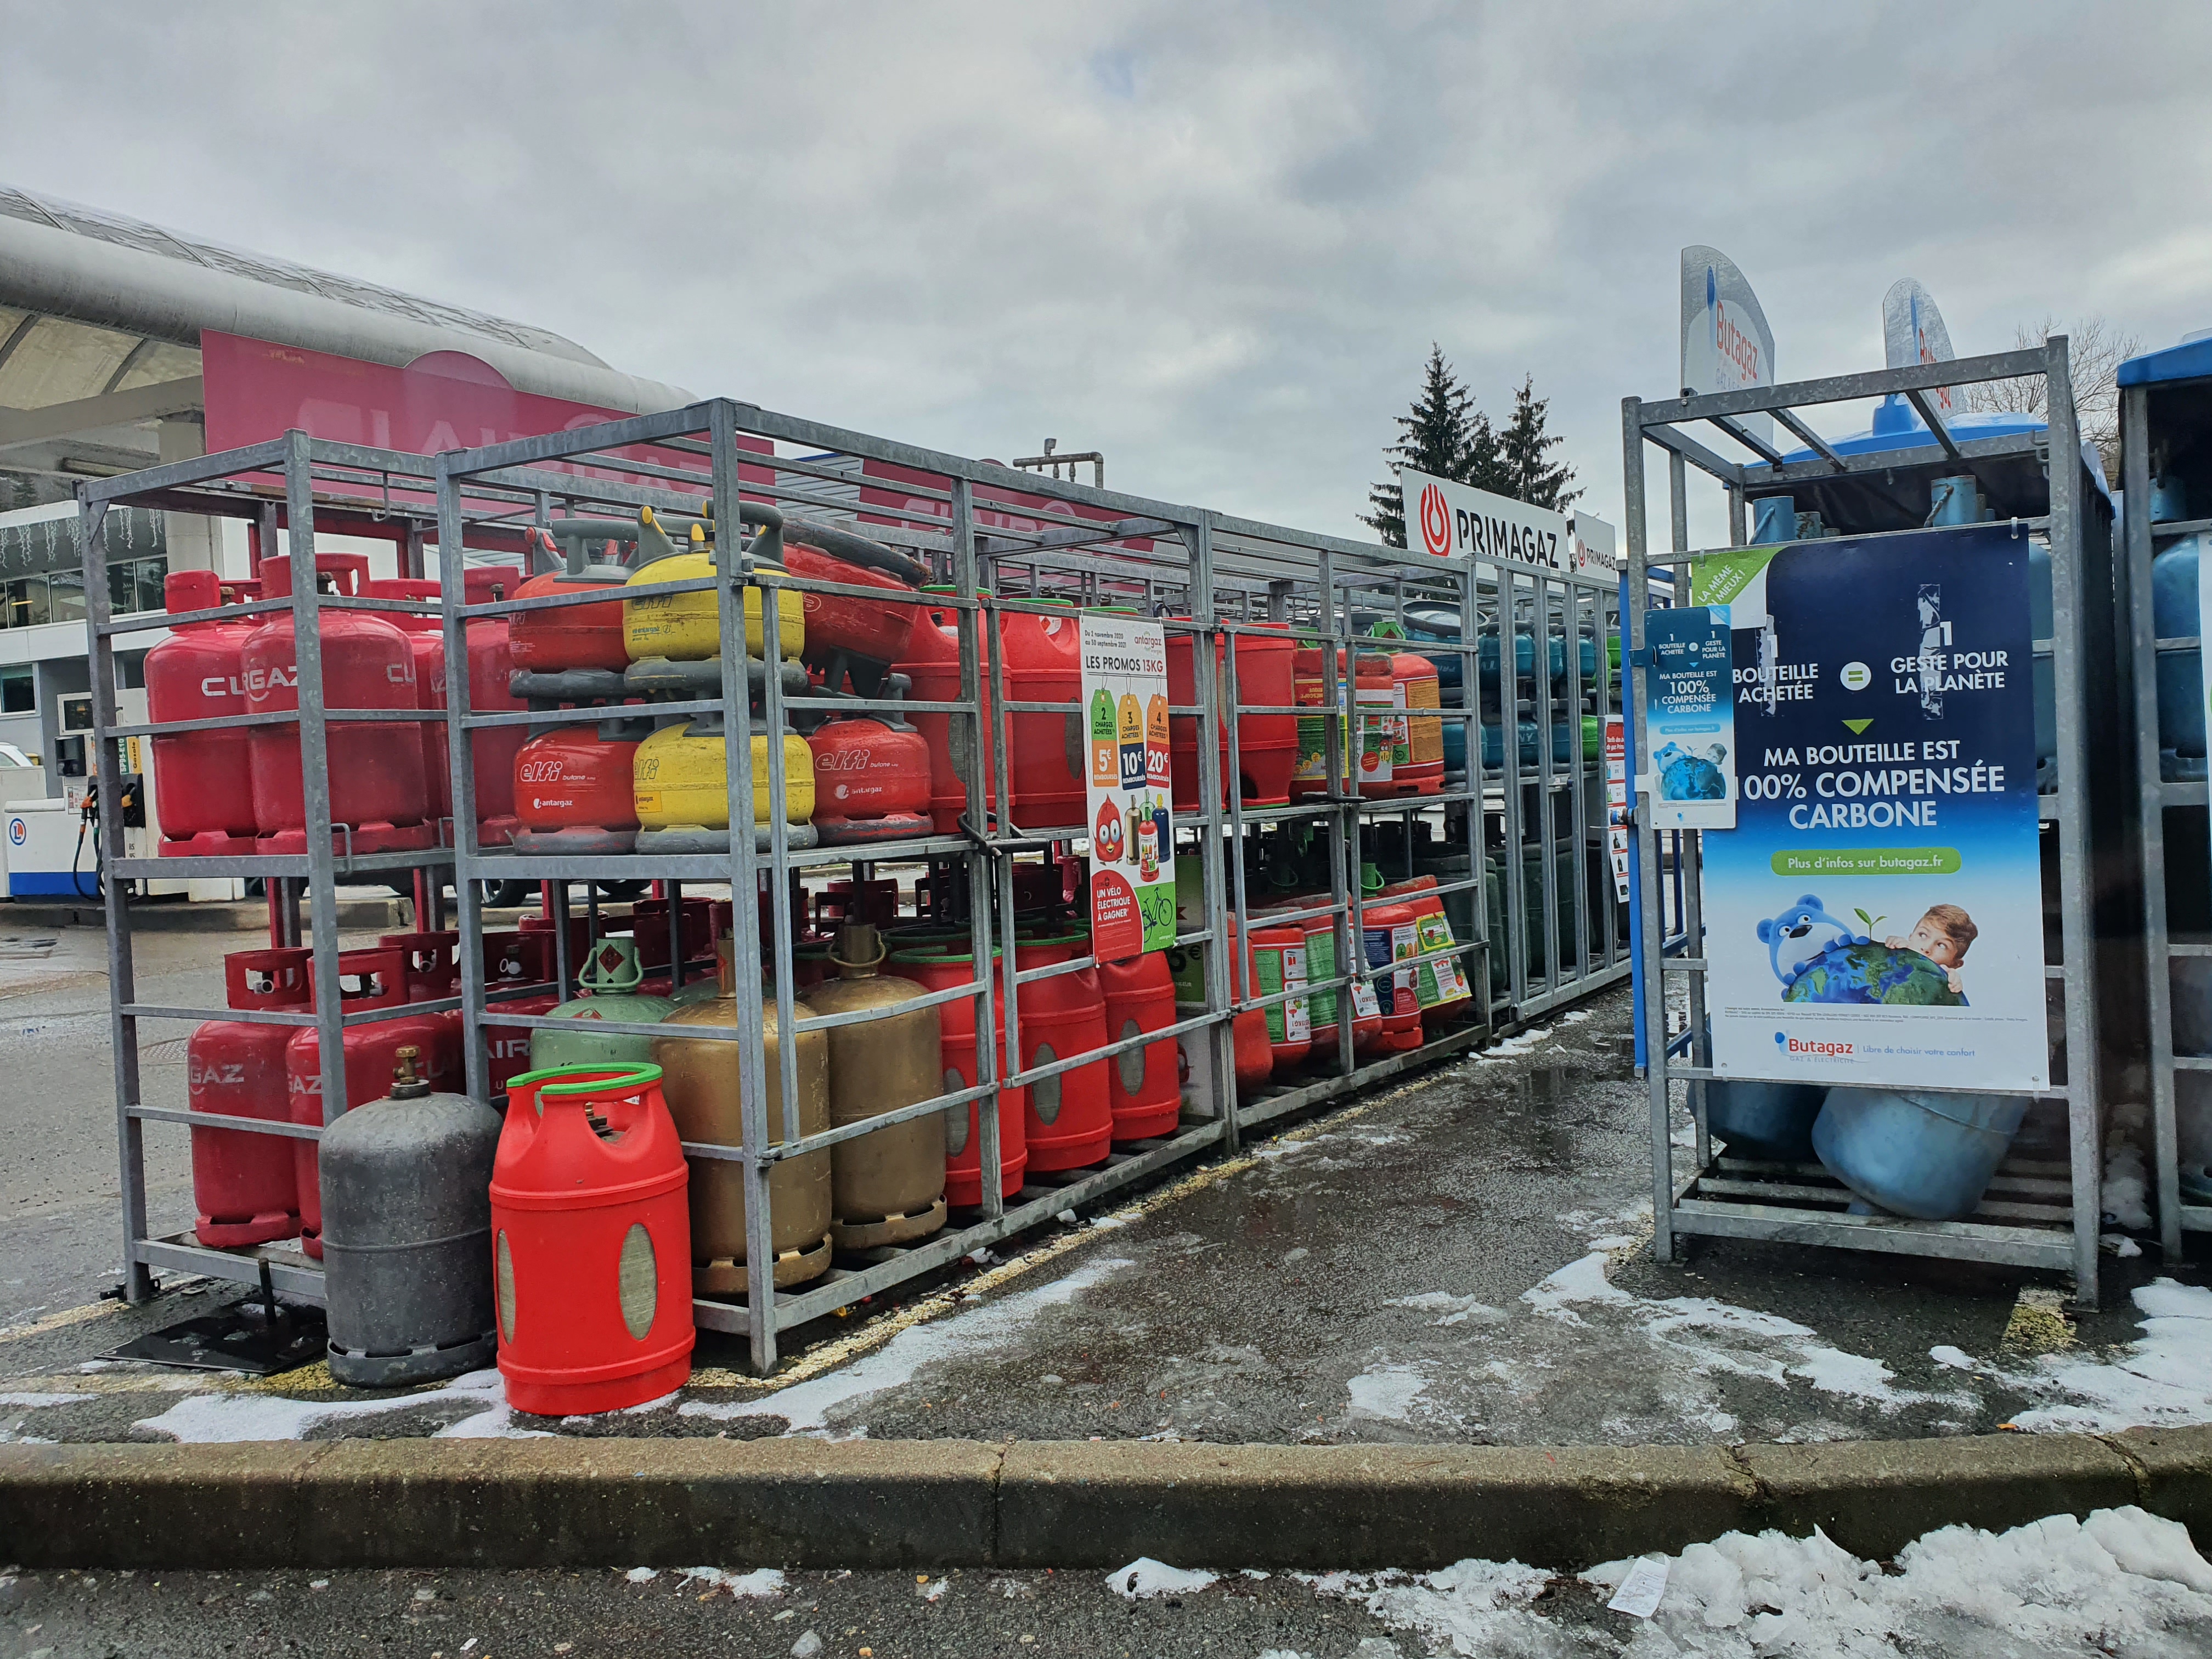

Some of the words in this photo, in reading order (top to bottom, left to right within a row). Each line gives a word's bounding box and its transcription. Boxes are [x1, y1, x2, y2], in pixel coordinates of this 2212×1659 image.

[1717, 300, 1758, 381] Butagaz
[1457, 509, 1559, 568] PRIMAGAZ
[1587, 548, 1616, 571] PRIMAGAZ
[1697, 590, 1711, 602] LA
[1708, 565, 1733, 591] MÊME
[1716, 573, 1742, 601] MIEUX
[1135, 635, 1161, 648] antargaz
[1940, 621, 1952, 646] 1
[1767, 635, 1778, 658] 1
[1086, 656, 1101, 669] LES
[1103, 657, 1141, 671] PROMOS
[1143, 659, 1163, 673] 13KG
[1891, 654, 1947, 673] GESTE
[1954, 651, 2008, 669] POUR
[1672, 672, 1705, 680] BOUTEILLE
[1733, 663, 1818, 684] BOUTEILLE
[1895, 678, 1918, 694] LA
[1924, 669, 2005, 692] PLANÈTE
[1661, 691, 1716, 704] COMPENSÉE
[1670, 680, 1709, 695] 100%
[1739, 680, 1813, 703] ACHETÉE
[1101, 707, 1106, 720] 2
[1127, 712, 1132, 724] 3
[1156, 712, 1161, 724] 4
[1667, 704, 1711, 714] CARBONE
[118, 738, 127, 772] SP95-E10
[815, 749, 870, 770] elfi
[1099, 749, 1111, 772] 5€
[1122, 751, 1142, 775] 10€
[1147, 750, 1169, 773] 20€
[1763, 748, 1799, 767] MA
[1807, 742, 1915, 765] BOUTEILLE
[1923, 740, 1960, 760] EST
[521, 760, 563, 782] elfi
[1815, 759, 2005, 798] COMPENSÉE
[541, 799, 573, 808] antargaz
[1789, 801, 1937, 830] CARBONE
[1788, 858, 1811, 868] Plus
[1814, 856, 1854, 869] d'infos
[1858, 859, 1876, 868] sur
[1880, 855, 1944, 870] butagaz.fr
[1097, 889, 1106, 898] UN
[1107, 884, 1121, 897] VÉLO
[1097, 896, 1130, 910] ÉLECTRIQUE
[1098, 910, 1102, 922] À
[1103, 909, 1127, 921] GAGNER
[1788, 1038, 1853, 1056] Butagaz
[1884, 1045, 1894, 1053] de
[1897, 1046, 1922, 1054] choisir
[1947, 1047, 1975, 1057] confort
